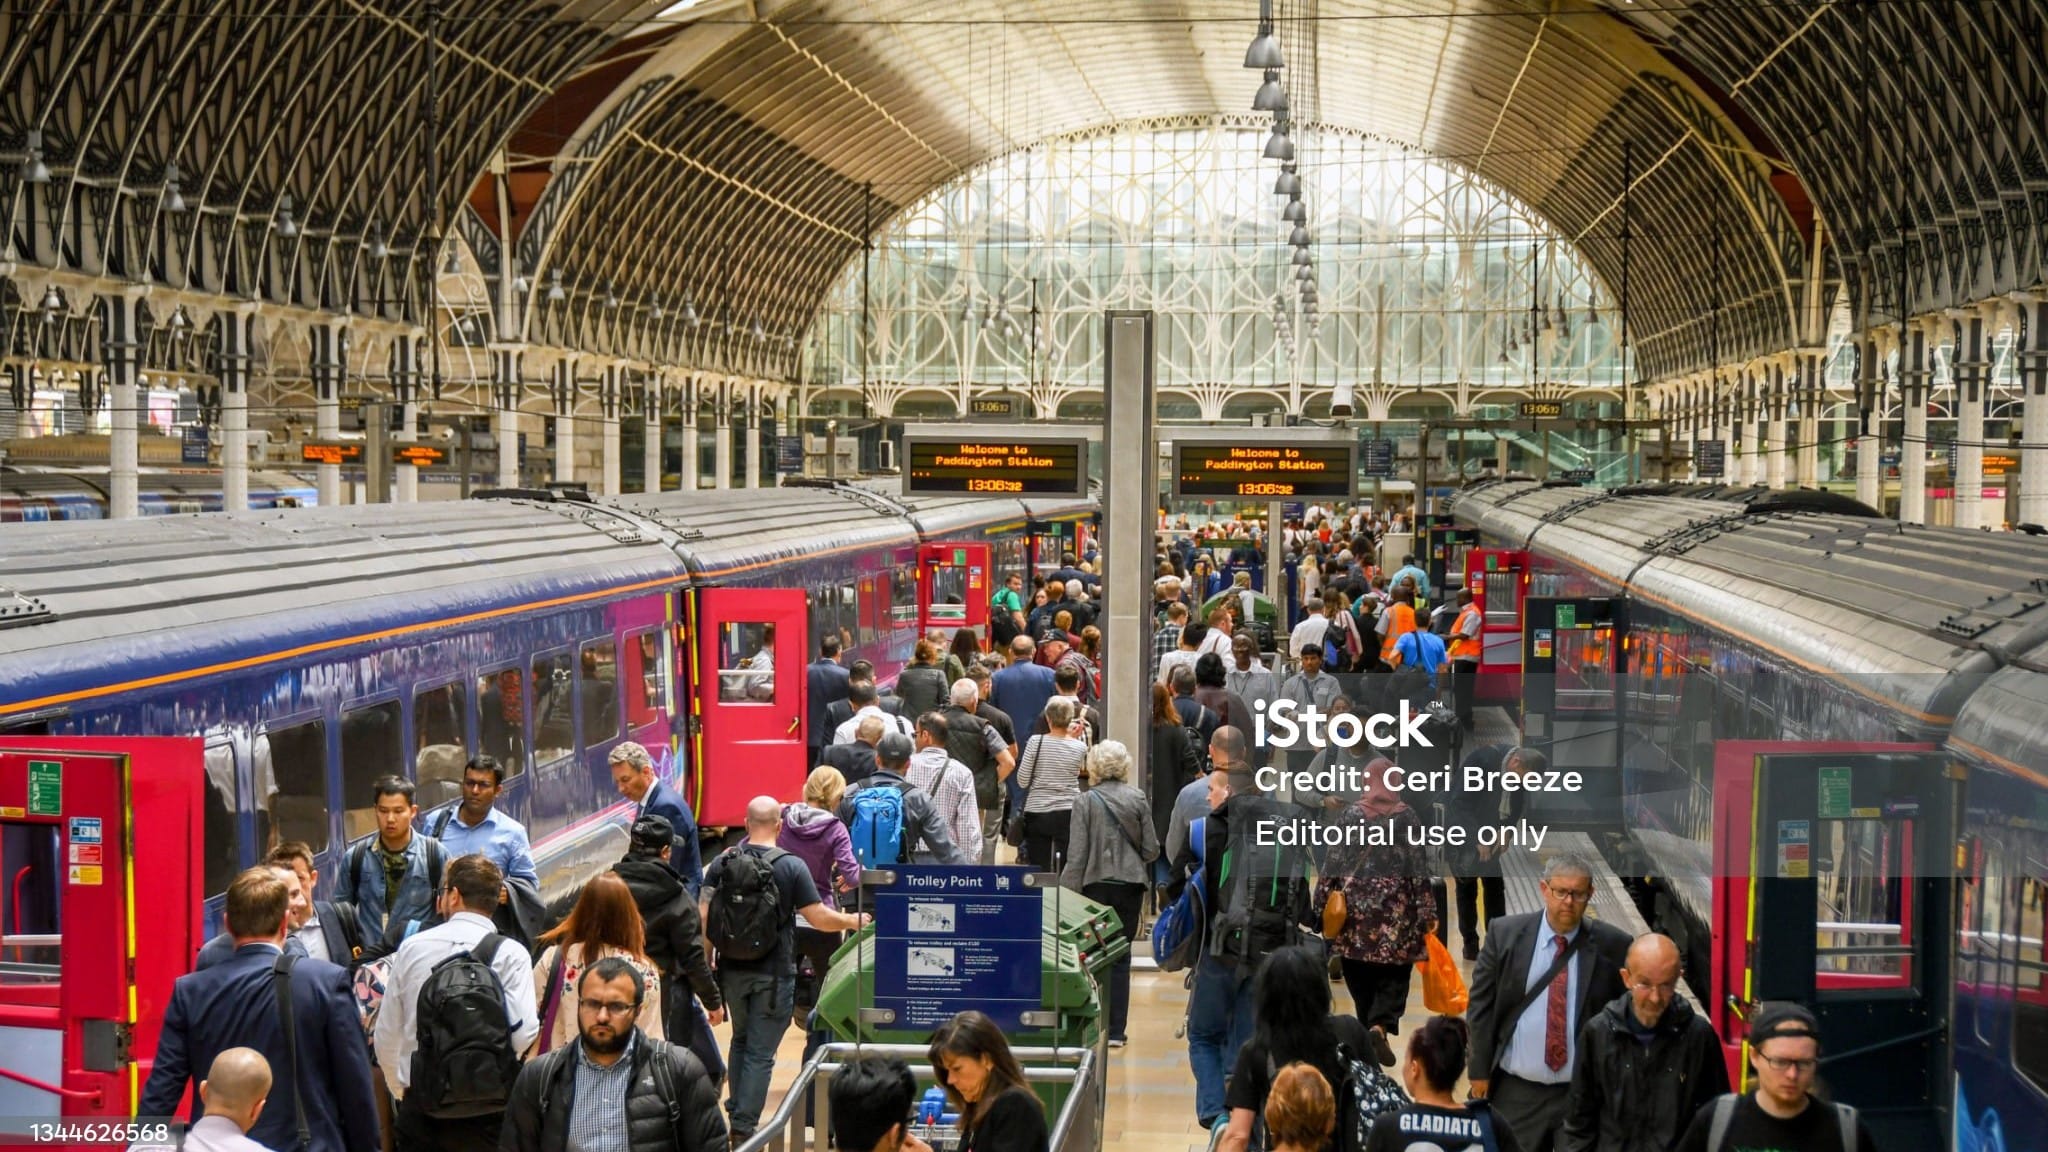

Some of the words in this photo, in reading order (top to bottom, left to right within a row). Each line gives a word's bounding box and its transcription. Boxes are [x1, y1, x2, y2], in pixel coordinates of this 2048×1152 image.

[960, 445, 1009, 454] Welcome
[1014, 445, 1028, 454] to
[1231, 448, 1280, 458] Welcome
[1285, 448, 1300, 458] to
[935, 456, 1003, 467] Paddington
[1007, 457, 1053, 467] Station
[1205, 460, 1274, 471] Paddington
[1278, 460, 1325, 471] Station
[968, 480, 1023, 492] 13:06:32
[1237, 483, 1294, 495] 13:06:32
[906, 874, 947, 888] Trolley
[950, 875, 983, 887] Point
